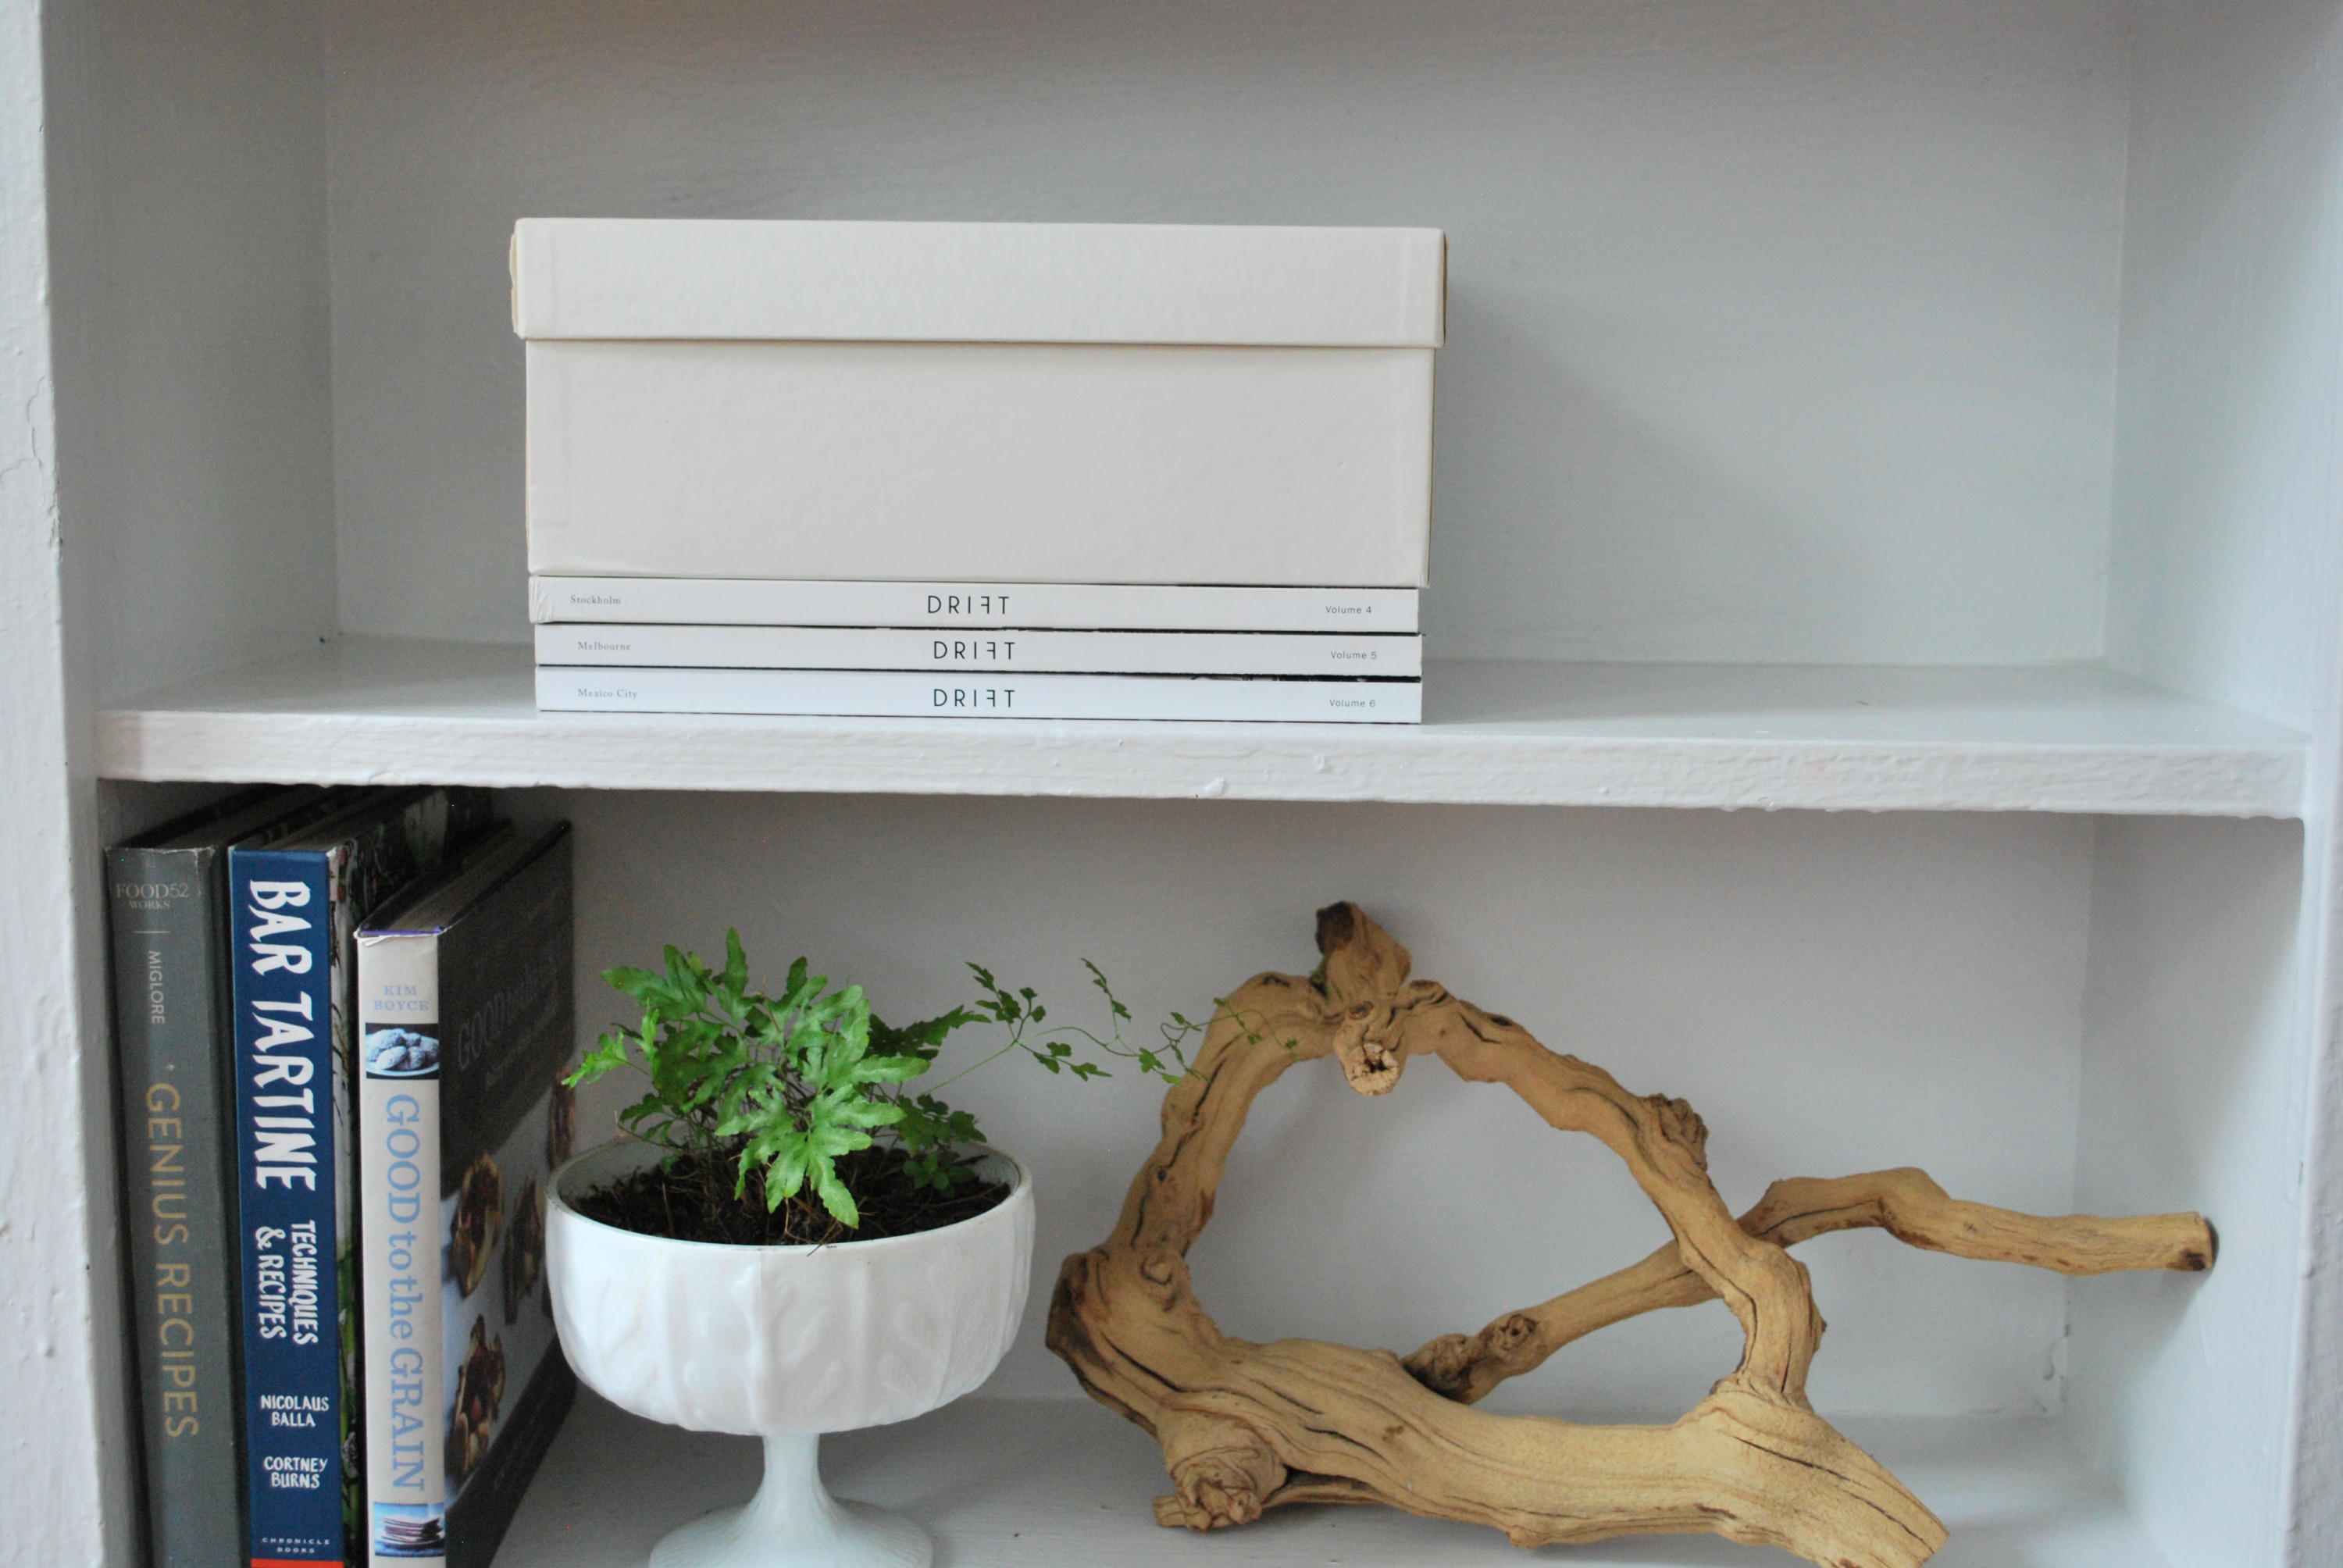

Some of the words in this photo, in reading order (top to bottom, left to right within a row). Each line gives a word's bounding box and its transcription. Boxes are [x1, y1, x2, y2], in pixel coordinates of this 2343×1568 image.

[569, 594, 622, 605] Stockholm
[928, 595, 1010, 615] DRIFT
[577, 641, 631, 650] Melbourne
[934, 641, 1015, 660] DRIFT
[1330, 650, 1367, 660] Volume
[1371, 651, 1377, 660] 5
[577, 688, 613, 697] Mexico
[616, 688, 637, 700] City
[933, 689, 1015, 707] DRIFT
[1329, 699, 1365, 707] Volume
[1369, 699, 1375, 707] 6
[116, 883, 191, 899] FOOD52
[129, 900, 171, 910] WORKS
[248, 879, 312, 976] BAR
[148, 950, 166, 1025] MIGLORE
[383, 985, 417, 996] KIM
[373, 1000, 430, 1010] BOYCE
[251, 991, 319, 1192] TARTINE
[145, 1083, 188, 1245] GENIUS
[386, 1094, 422, 1224] GOOD
[255, 1225, 286, 1250] &
[388, 1231, 418, 1271] to
[288, 1219, 319, 1345] TECHNIQUES
[256, 1254, 287, 1340] RECIPES
[388, 1276, 424, 1340] the
[155, 1263, 199, 1438] RECIPES
[260, 1395, 330, 1412] NICOLAUS
[271, 1411, 316, 1427] BALLA
[390, 1347, 425, 1490] GRAIN
[263, 1456, 329, 1473] CORTNEY
[270, 1473, 320, 1488] BURNS
[262, 1537, 330, 1545] CHRONICLE
